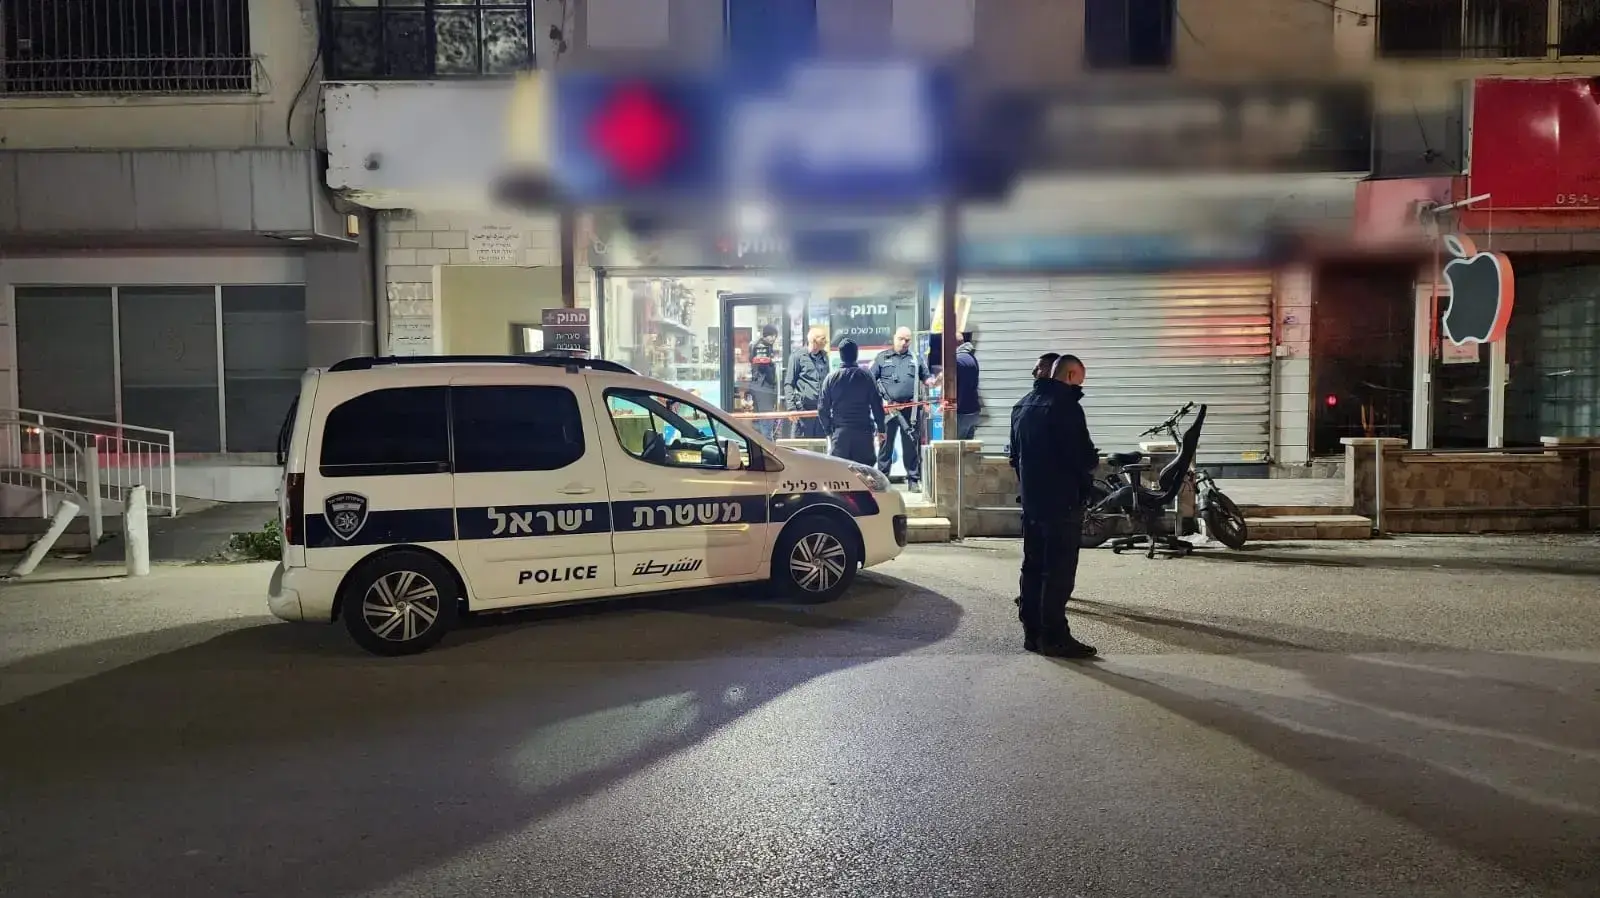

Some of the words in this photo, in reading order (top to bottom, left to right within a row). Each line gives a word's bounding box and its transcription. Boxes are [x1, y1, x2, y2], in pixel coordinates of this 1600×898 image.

[850, 304, 888, 319] מתוק
[851, 326, 874, 336] לשלם
[782, 479, 818, 492] פלילי
[487, 507, 593, 536] ישראל
[632, 501, 742, 528] משטרת
[518, 564, 598, 585] POLICE
[632, 555, 703, 577] الشرطة
